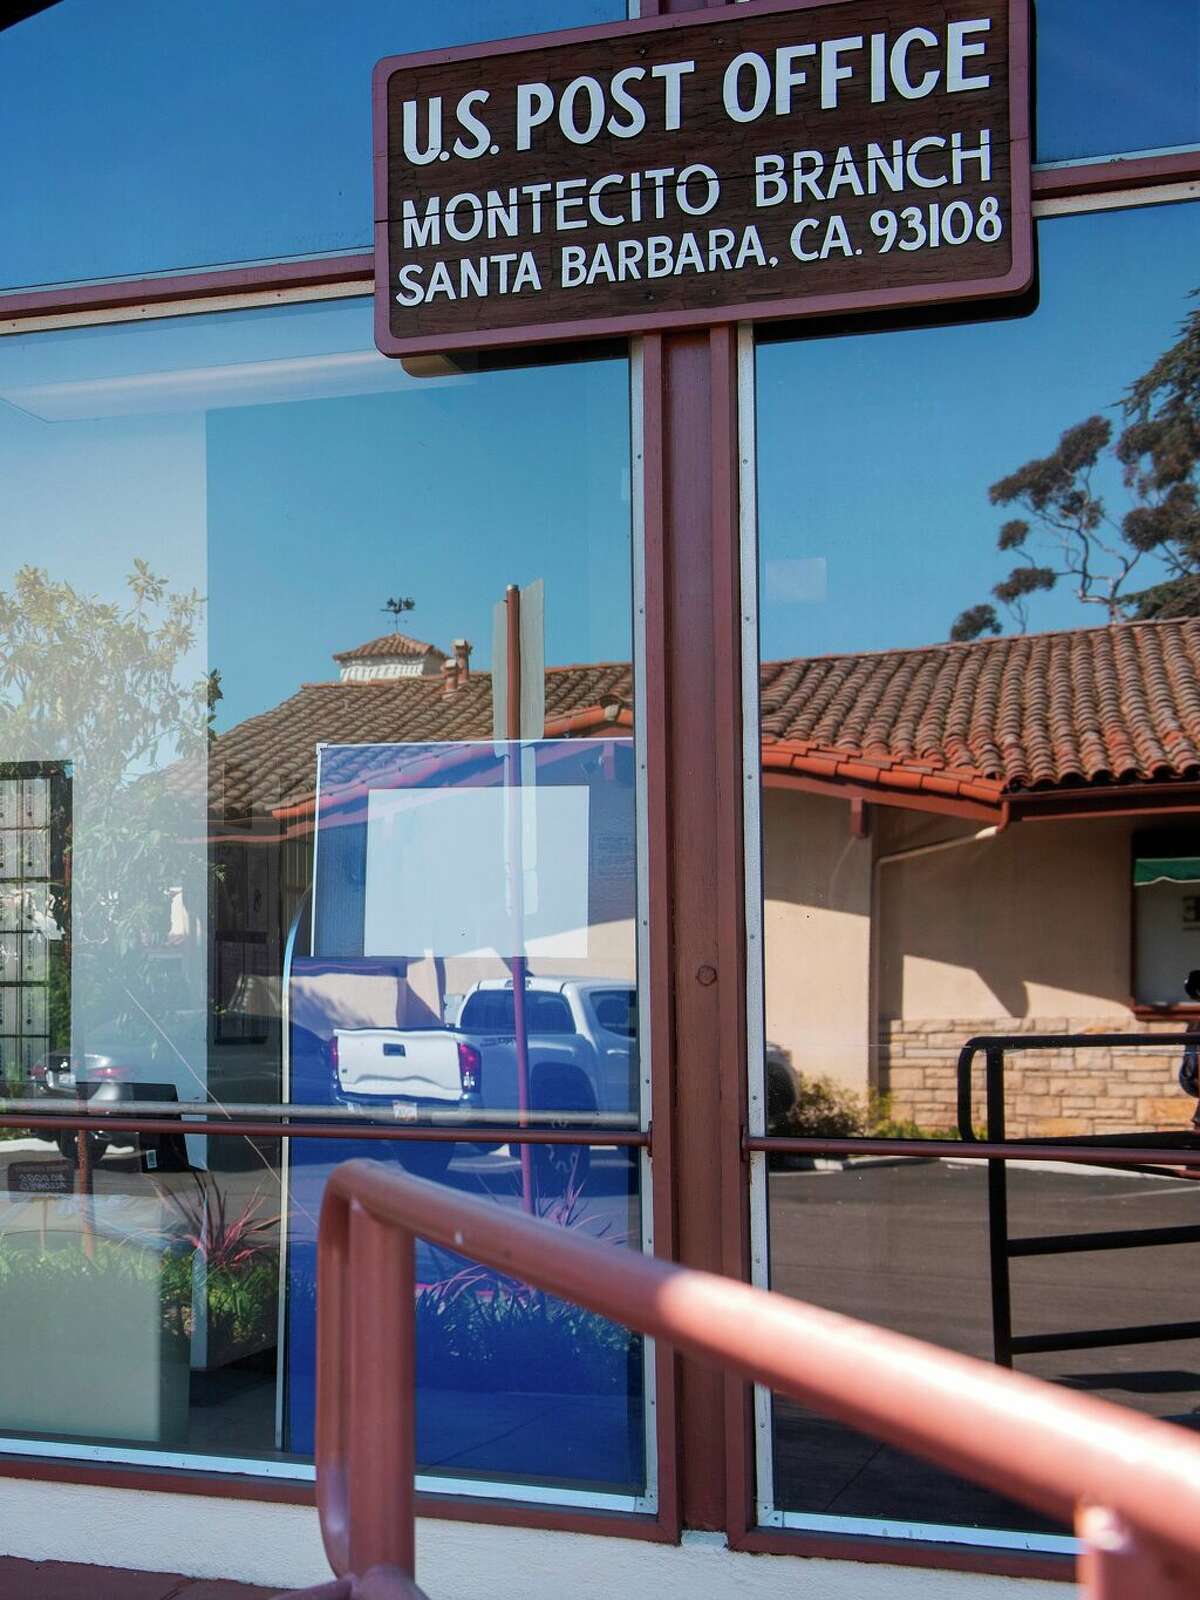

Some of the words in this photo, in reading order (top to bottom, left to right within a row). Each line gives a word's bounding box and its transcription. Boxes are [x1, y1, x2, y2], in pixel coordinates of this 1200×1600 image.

[402, 89, 499, 165] U.S.
[515, 60, 696, 151] POST
[722, 18, 992, 125] OFFICE
[402, 163, 721, 249] MONTECITO
[754, 129, 992, 208] BRANCH
[395, 251, 543, 307] SANTA
[560, 225, 779, 288] BARBARA,
[789, 217, 865, 262] CA.
[869, 197, 1003, 253] 93108
